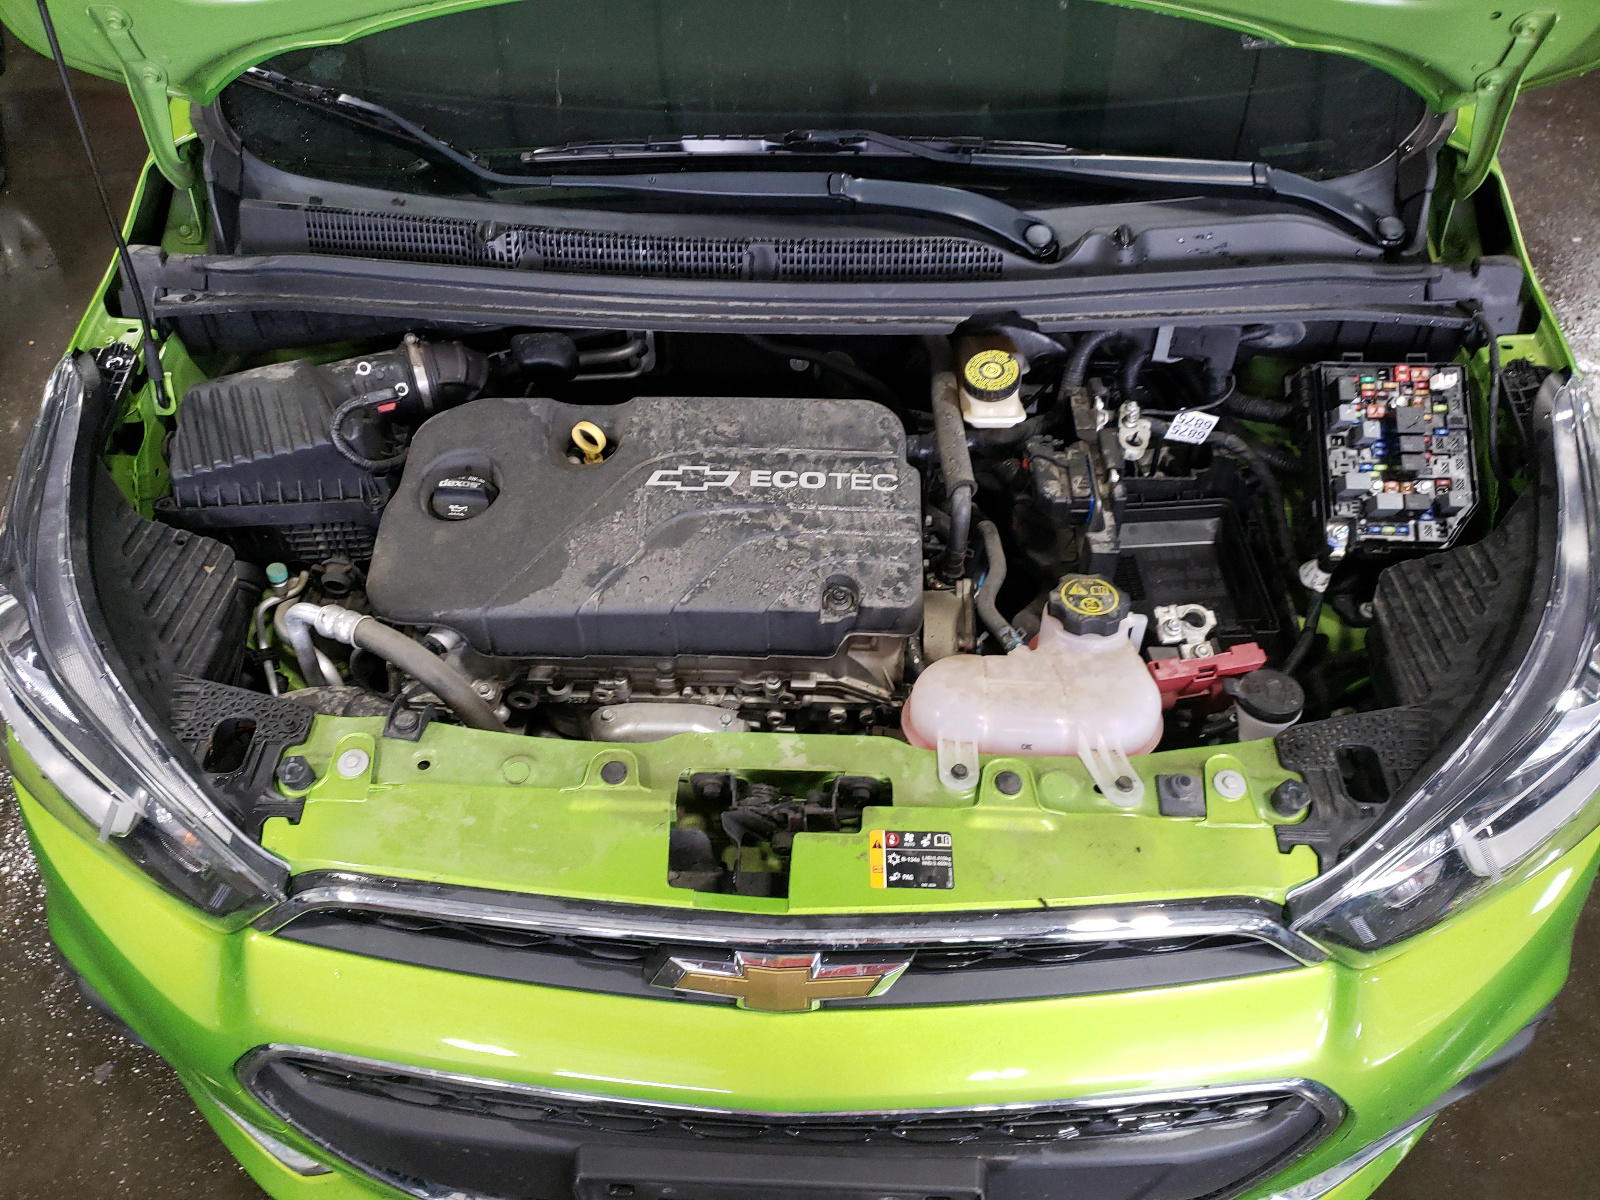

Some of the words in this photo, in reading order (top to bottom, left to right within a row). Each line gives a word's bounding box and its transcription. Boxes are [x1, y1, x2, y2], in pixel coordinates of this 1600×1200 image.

[1171, 424, 1207, 440] 6875
[750, 470, 900, 492] ECOTEC
[902, 873, 914, 881] PAG
